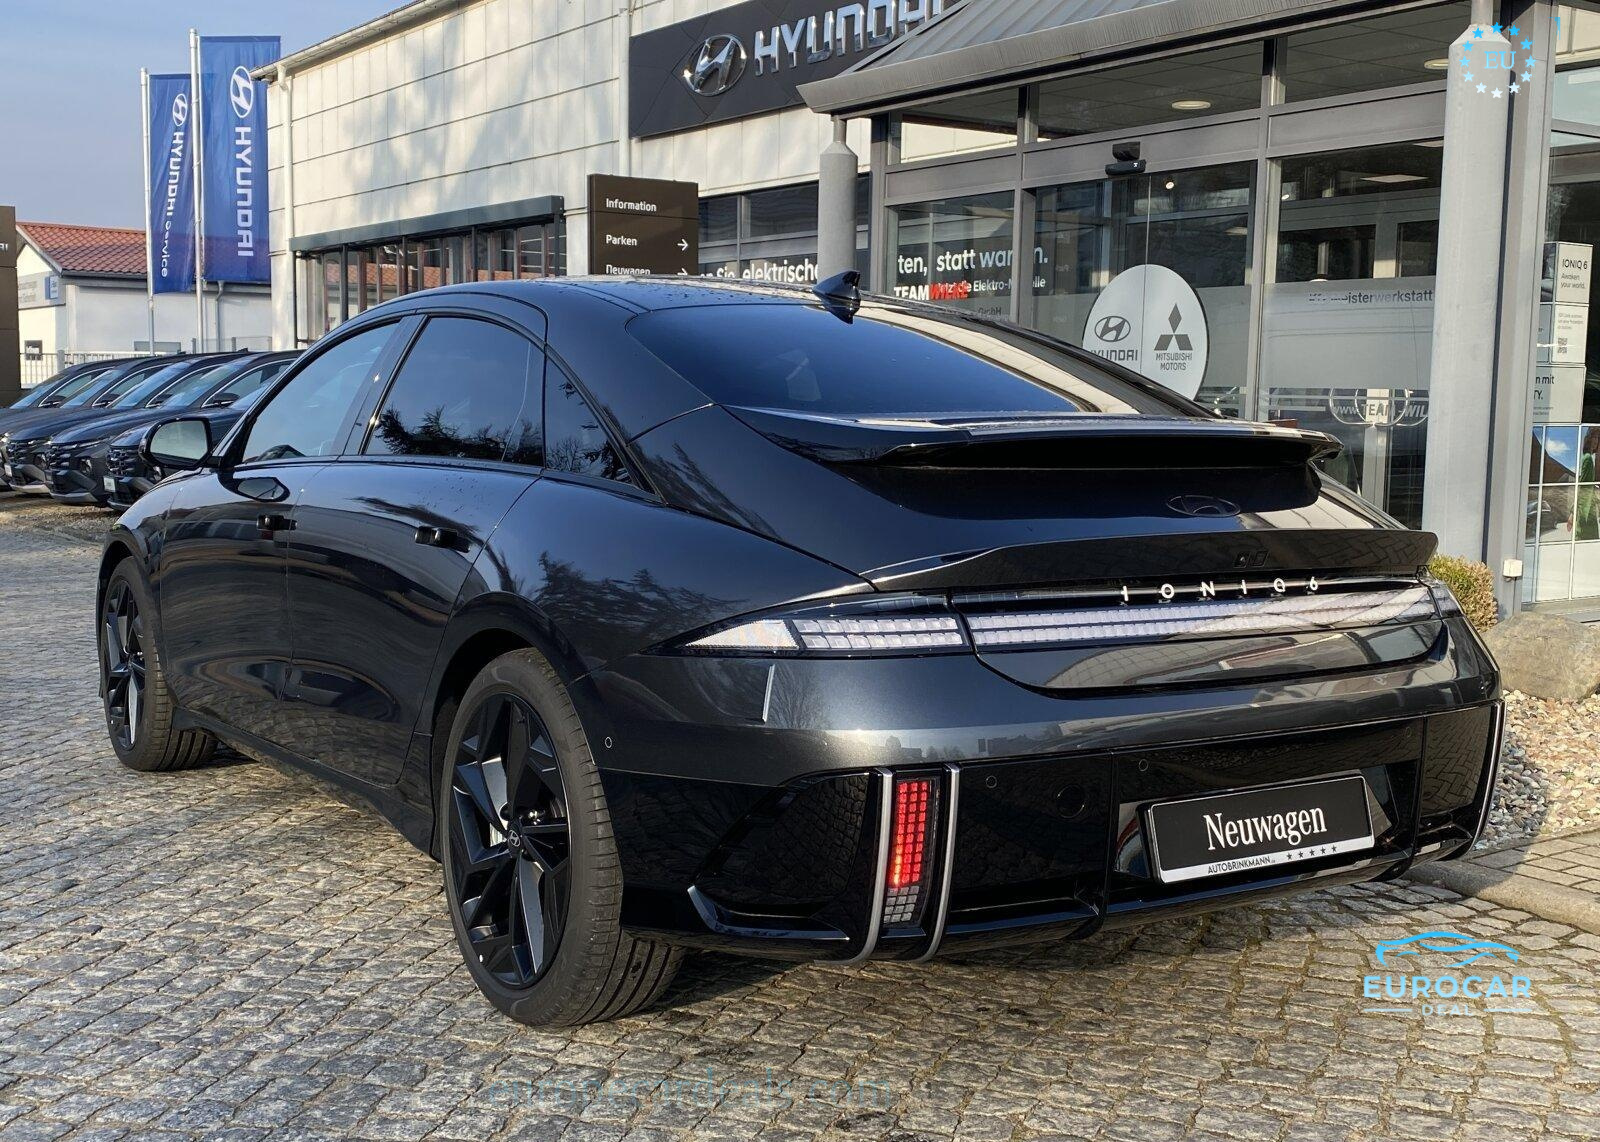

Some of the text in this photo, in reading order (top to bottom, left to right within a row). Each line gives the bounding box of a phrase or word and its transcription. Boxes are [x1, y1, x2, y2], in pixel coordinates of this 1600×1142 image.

[166, 131, 185, 216] HYUNDAI
[234, 126, 254, 257] HYUNDAI
[606, 198, 657, 212] Information
[606, 235, 637, 246] Parken
[898, 255, 928, 276] ten,
[936, 249, 976, 272] statt
[1562, 258, 1588, 270] IONIQ 6
[742, 258, 819, 283] elektrisch
[1091, 349, 1139, 361] YUNDAI
[1155, 352, 1193, 361] MITSUBISHI
[1160, 362, 1187, 371] MOTORS
[1203, 807, 1327, 850] Neuwagen
